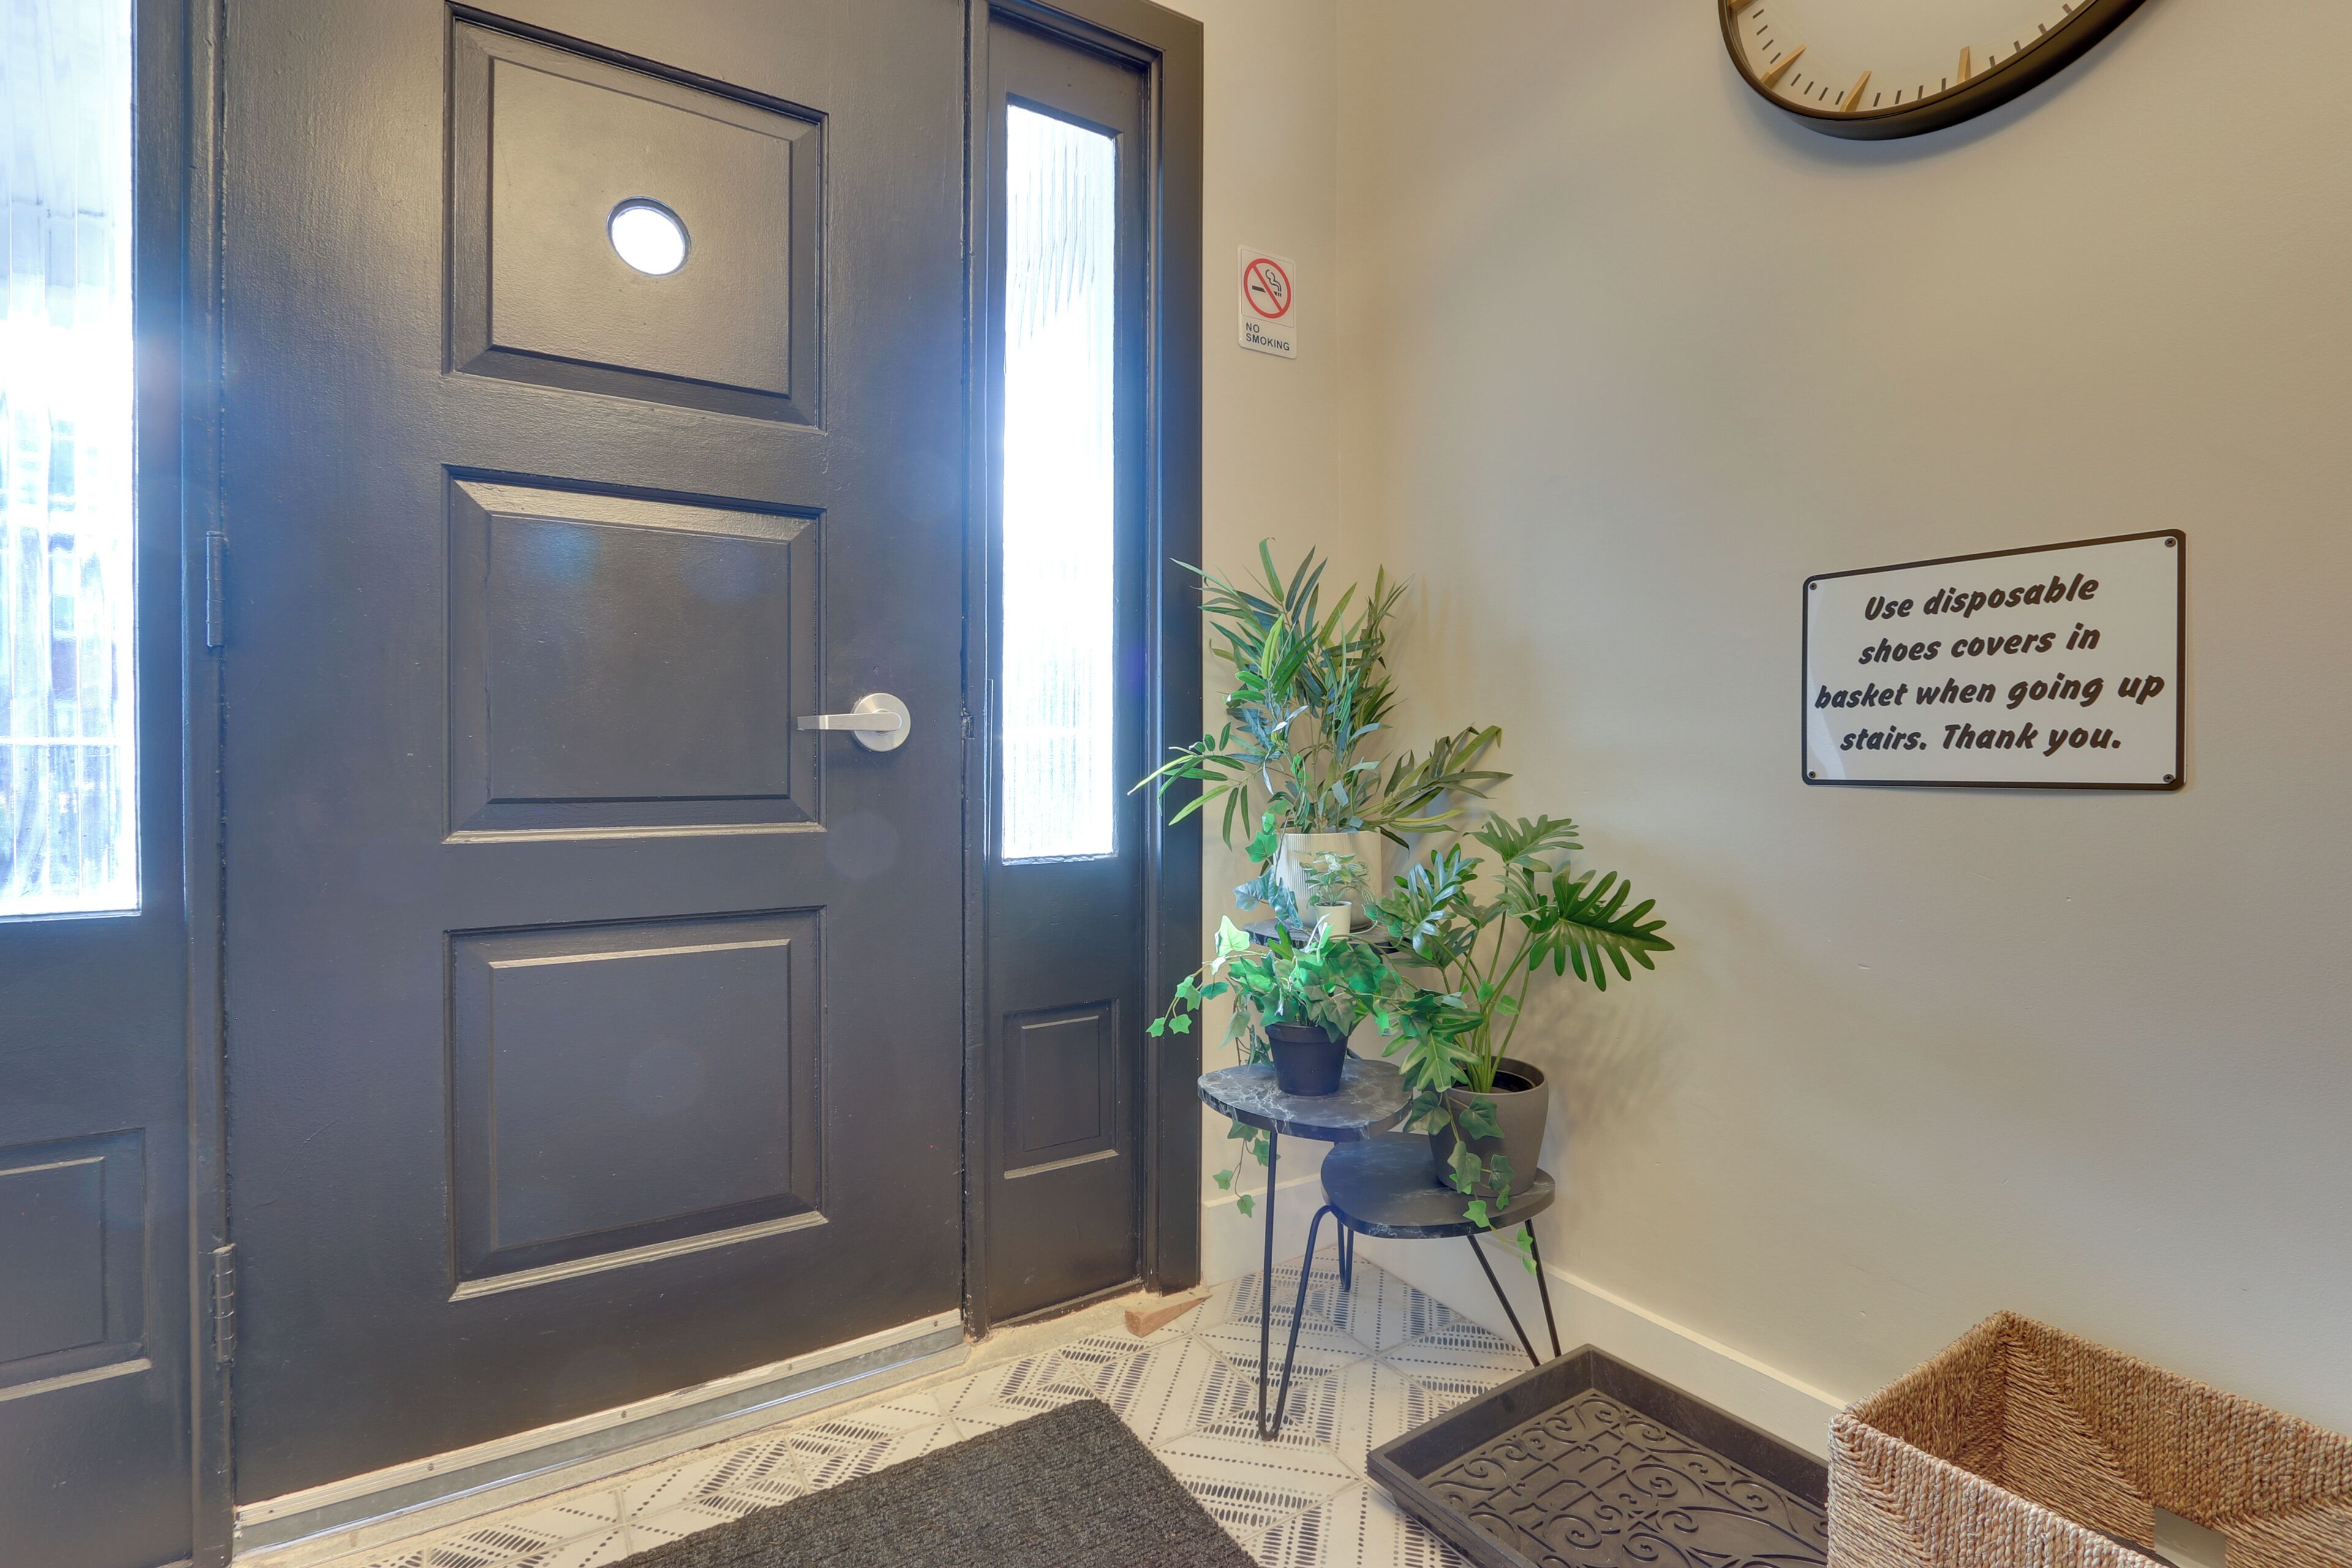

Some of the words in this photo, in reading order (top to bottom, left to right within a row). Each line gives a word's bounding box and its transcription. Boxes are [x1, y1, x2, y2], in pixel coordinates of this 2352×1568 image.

[1246, 322, 1260, 333] NO
[1246, 333, 1290, 351] SMOKING
[1864, 595, 1914, 620] Use
[1923, 573, 2099, 619] disposable
[1858, 638, 1942, 665] shoes
[1951, 632, 2056, 658] covers
[2065, 622, 2100, 650] in
[1814, 682, 1909, 709] basket
[1916, 677, 1996, 705] when
[2006, 672, 2104, 710] going
[2117, 674, 2165, 706] up
[1839, 725, 1928, 751] stairs.
[1942, 722, 2038, 750] Thank
[2043, 726, 2121, 757] you.
